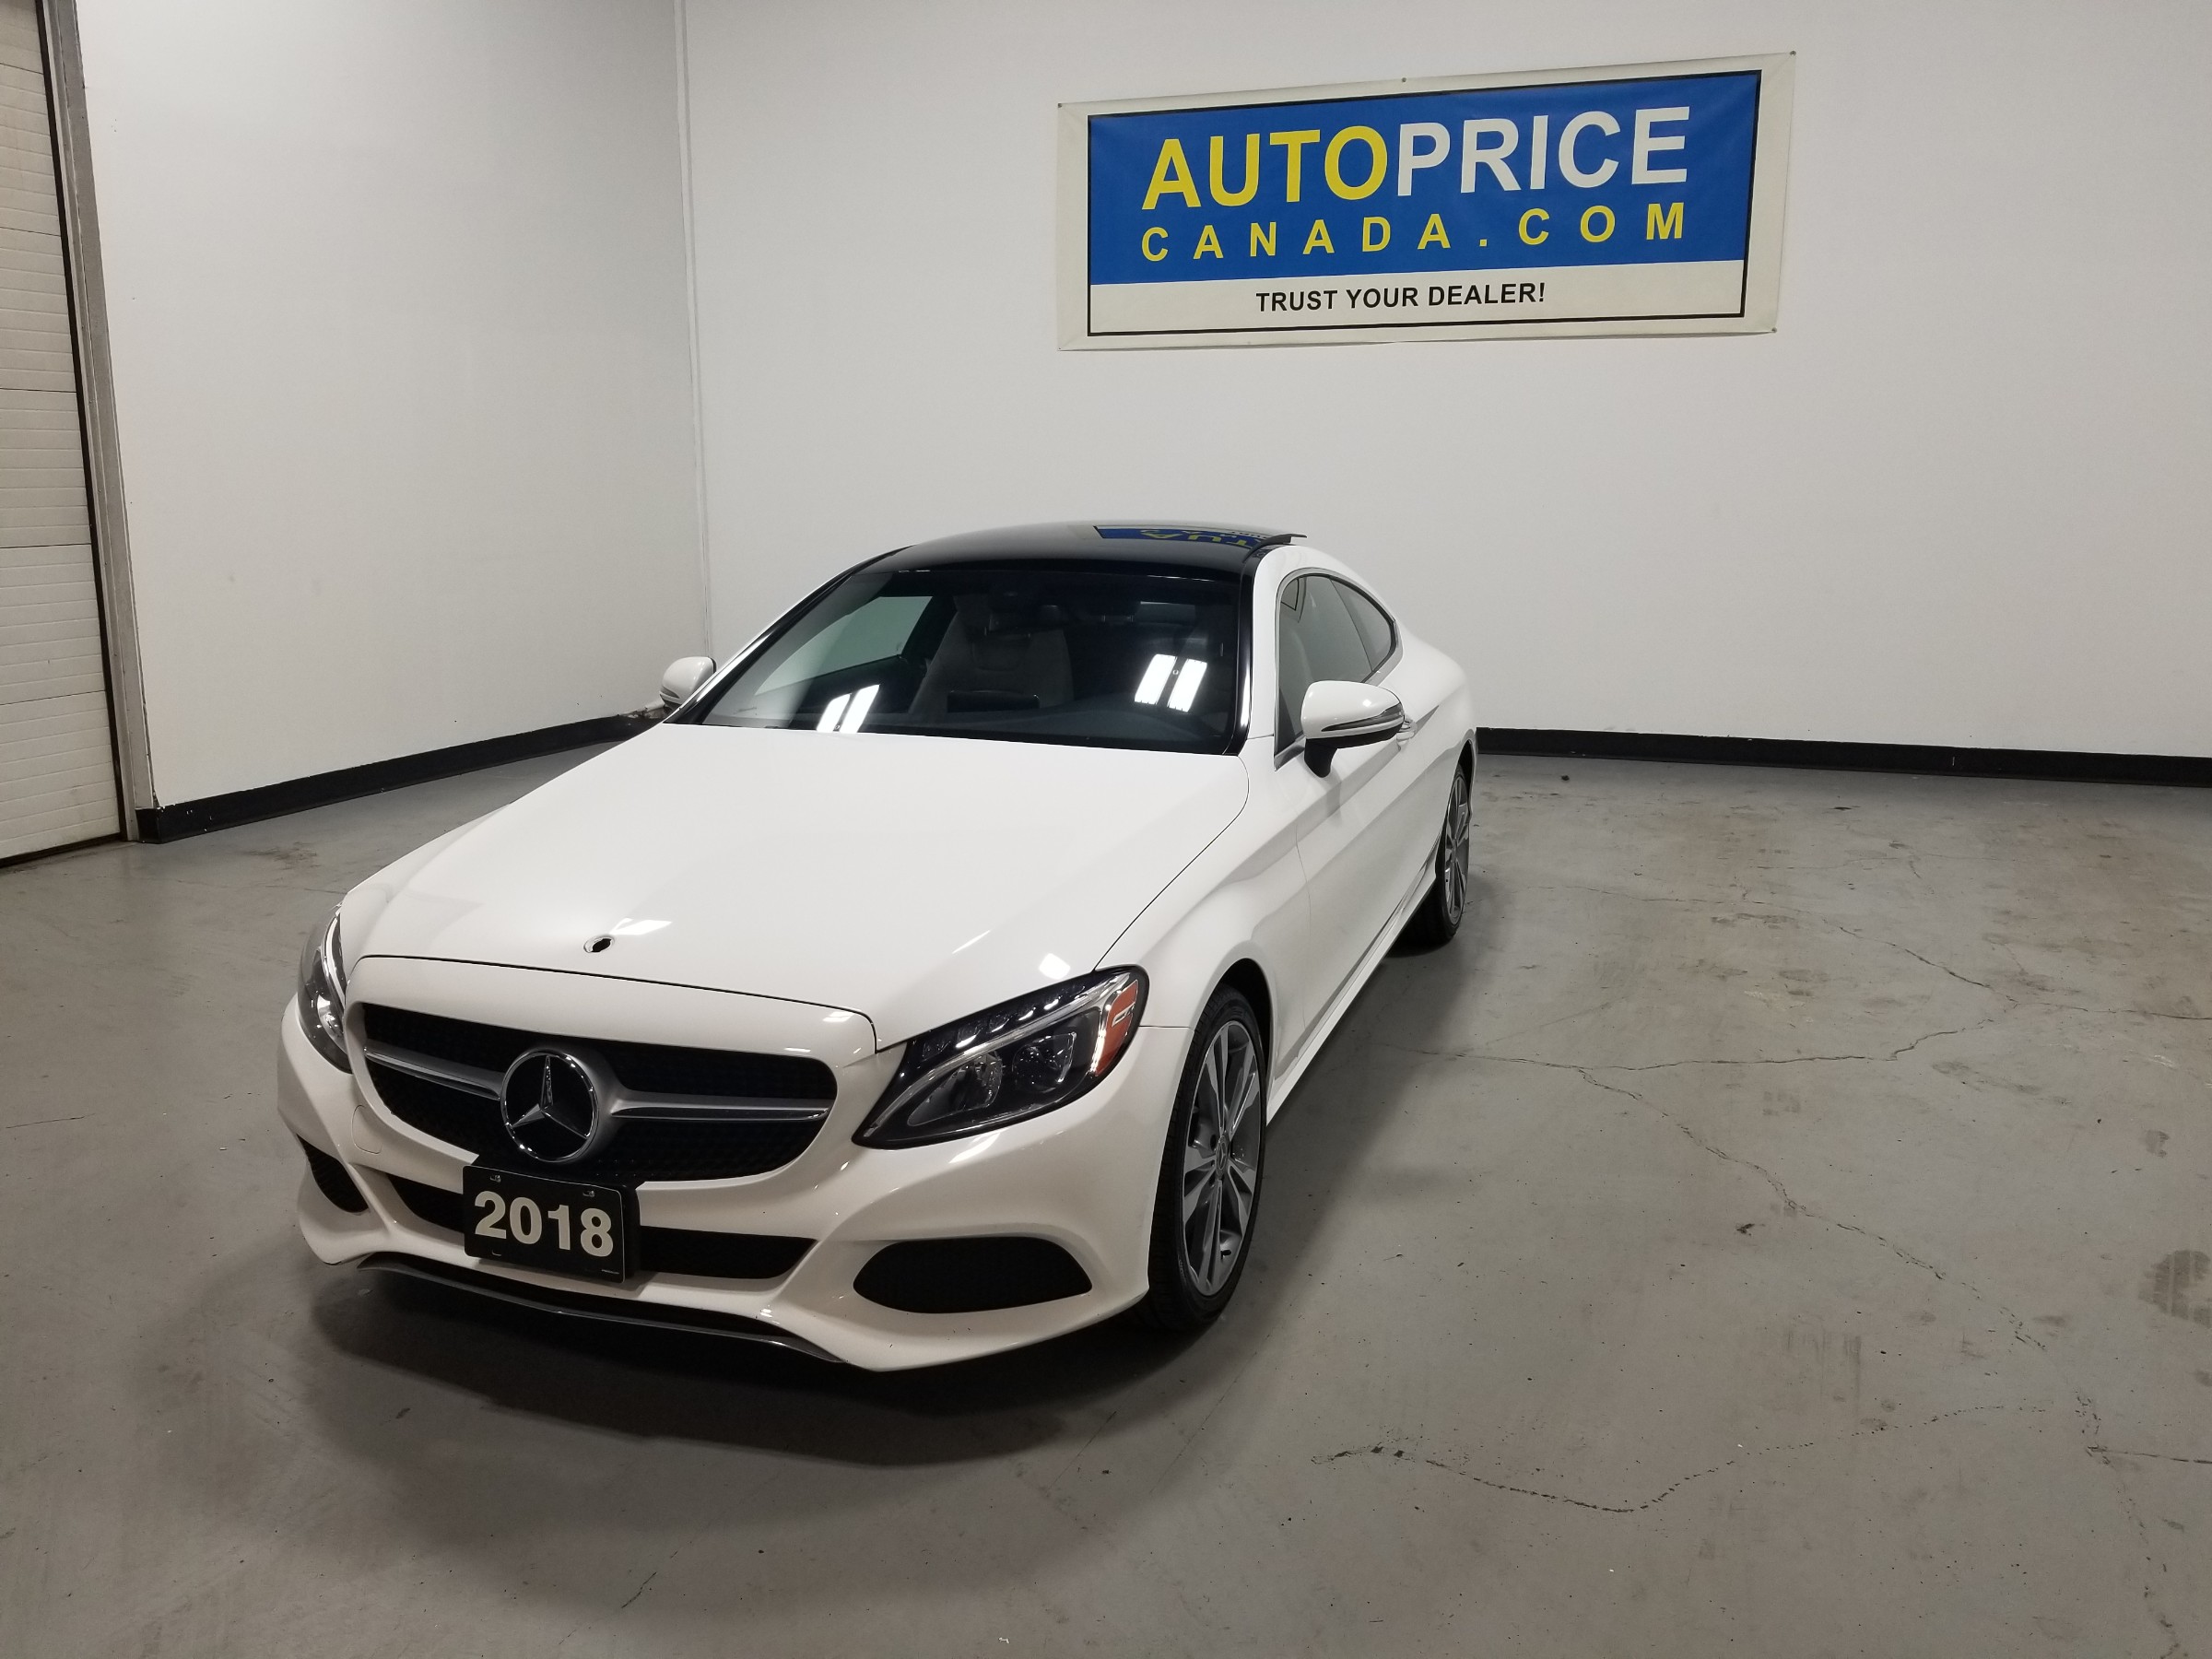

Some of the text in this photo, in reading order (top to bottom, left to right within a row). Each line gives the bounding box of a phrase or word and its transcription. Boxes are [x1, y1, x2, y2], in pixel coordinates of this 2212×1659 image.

[1141, 106, 1691, 210] AUTOPRICE
[1140, 202, 1686, 262] CANADA.COM
[1255, 282, 1547, 312] TRUST YOUR DEALER!
[474, 1190, 614, 1257] 2018
